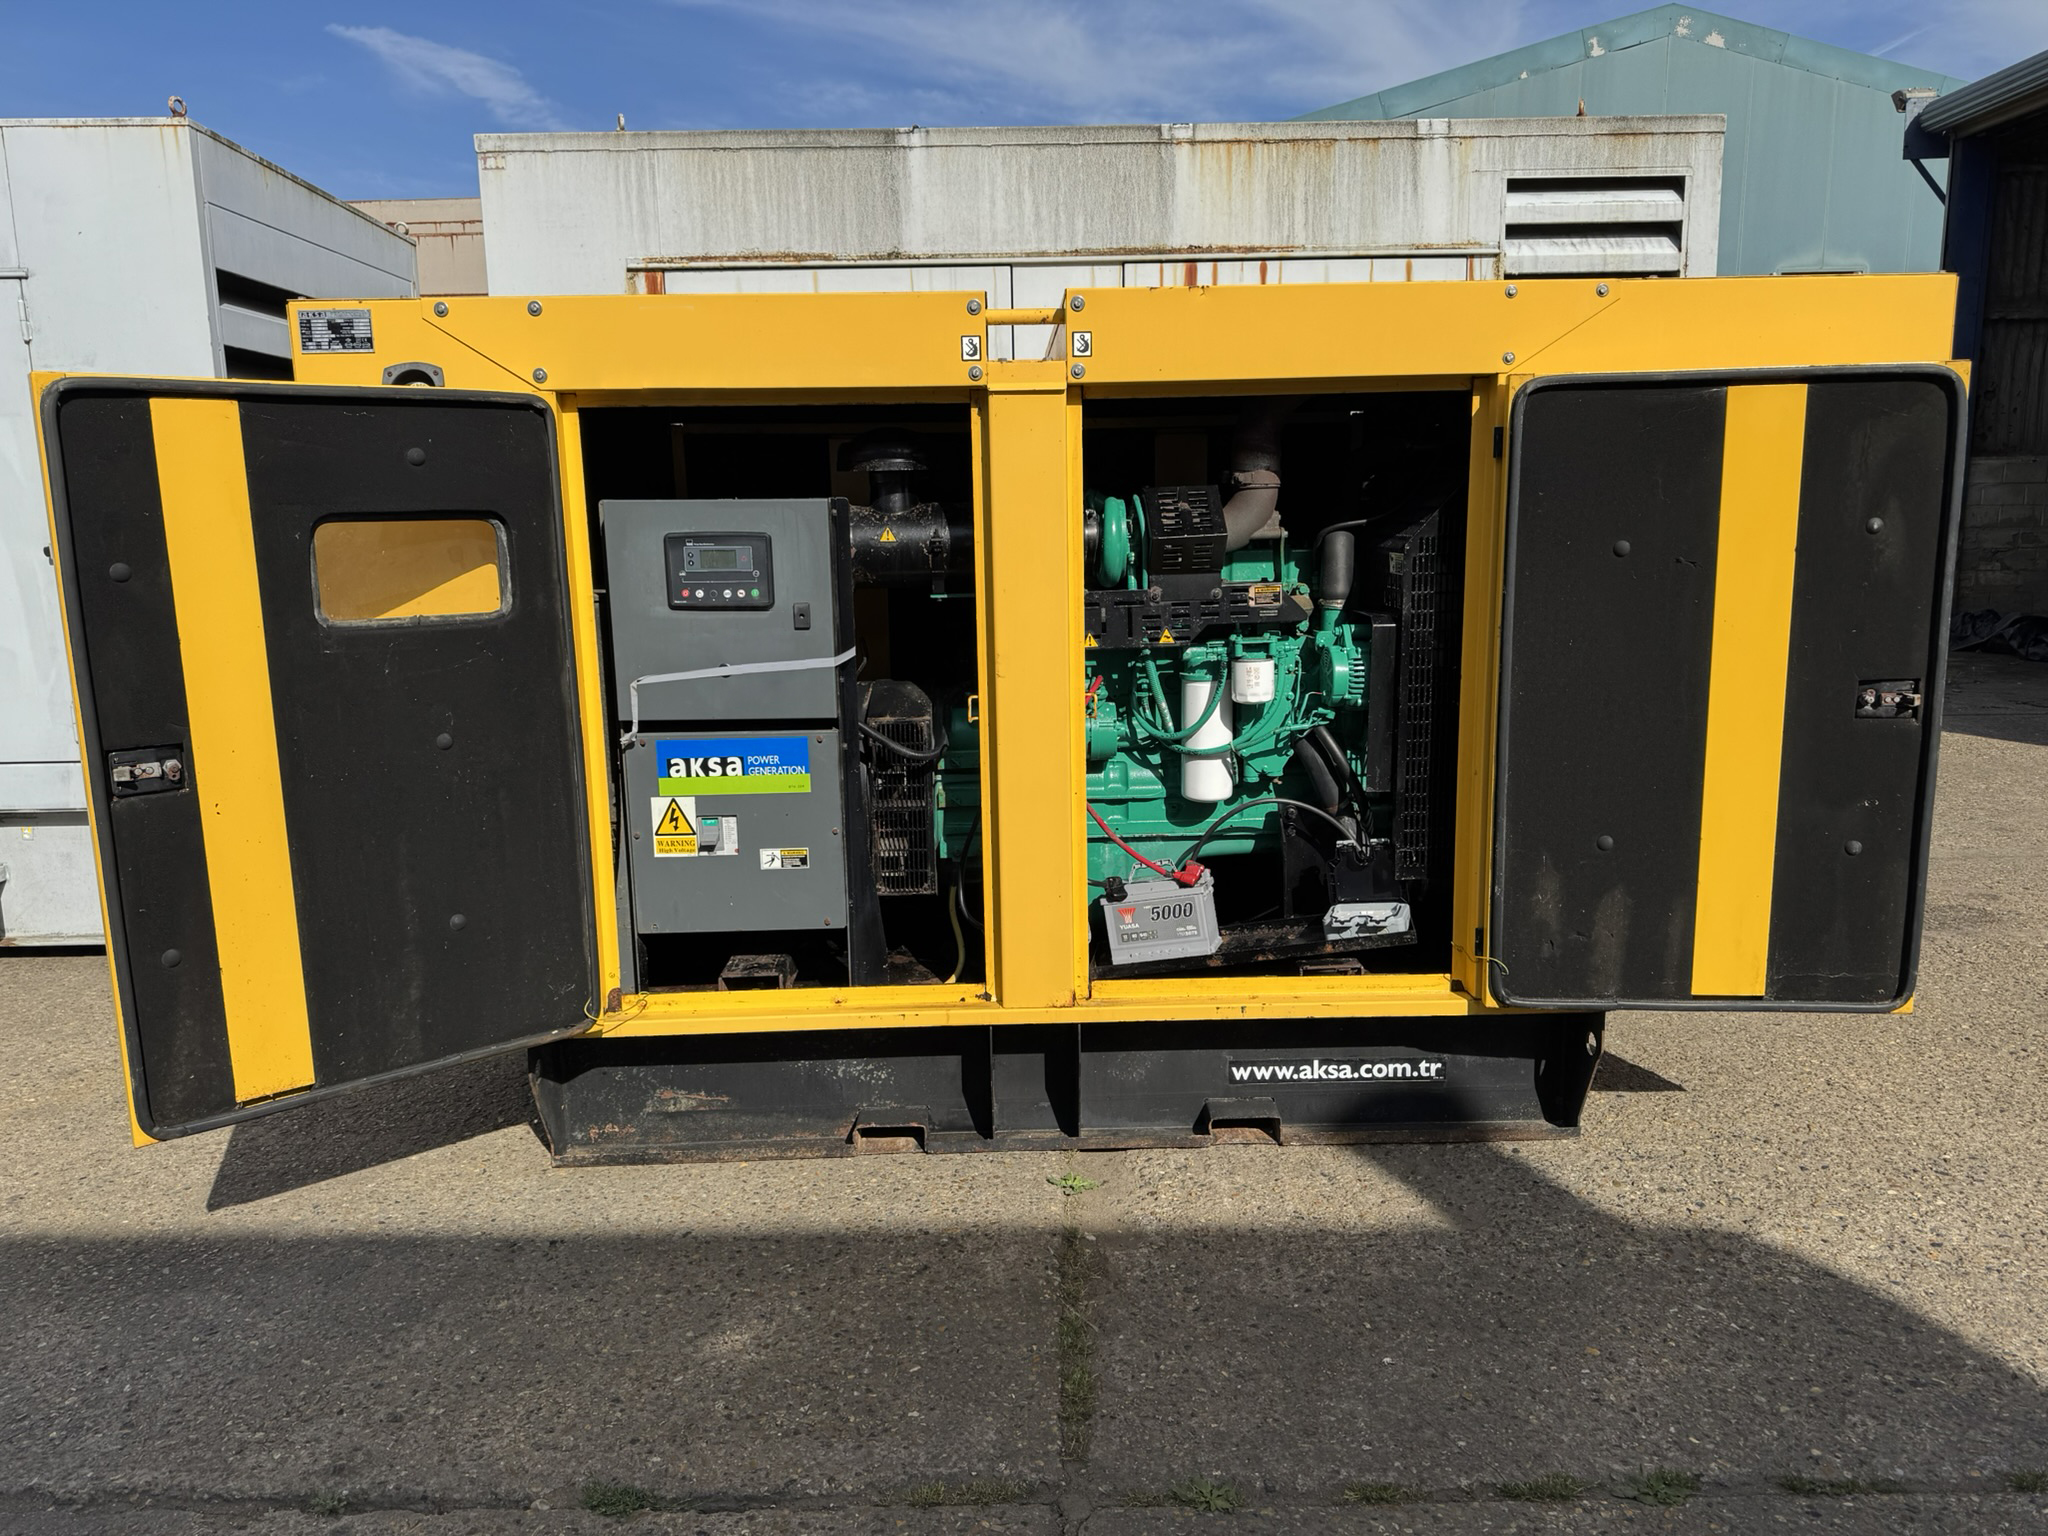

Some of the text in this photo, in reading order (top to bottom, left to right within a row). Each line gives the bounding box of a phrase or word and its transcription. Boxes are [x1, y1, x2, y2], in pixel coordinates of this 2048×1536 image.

[669, 756, 744, 778] aksa
[747, 755, 780, 765] POWER
[748, 765, 806, 776] GENERATION
[1150, 902, 1194, 922] 5000
[1231, 1059, 1443, 1081] www.aksa.com.tr
